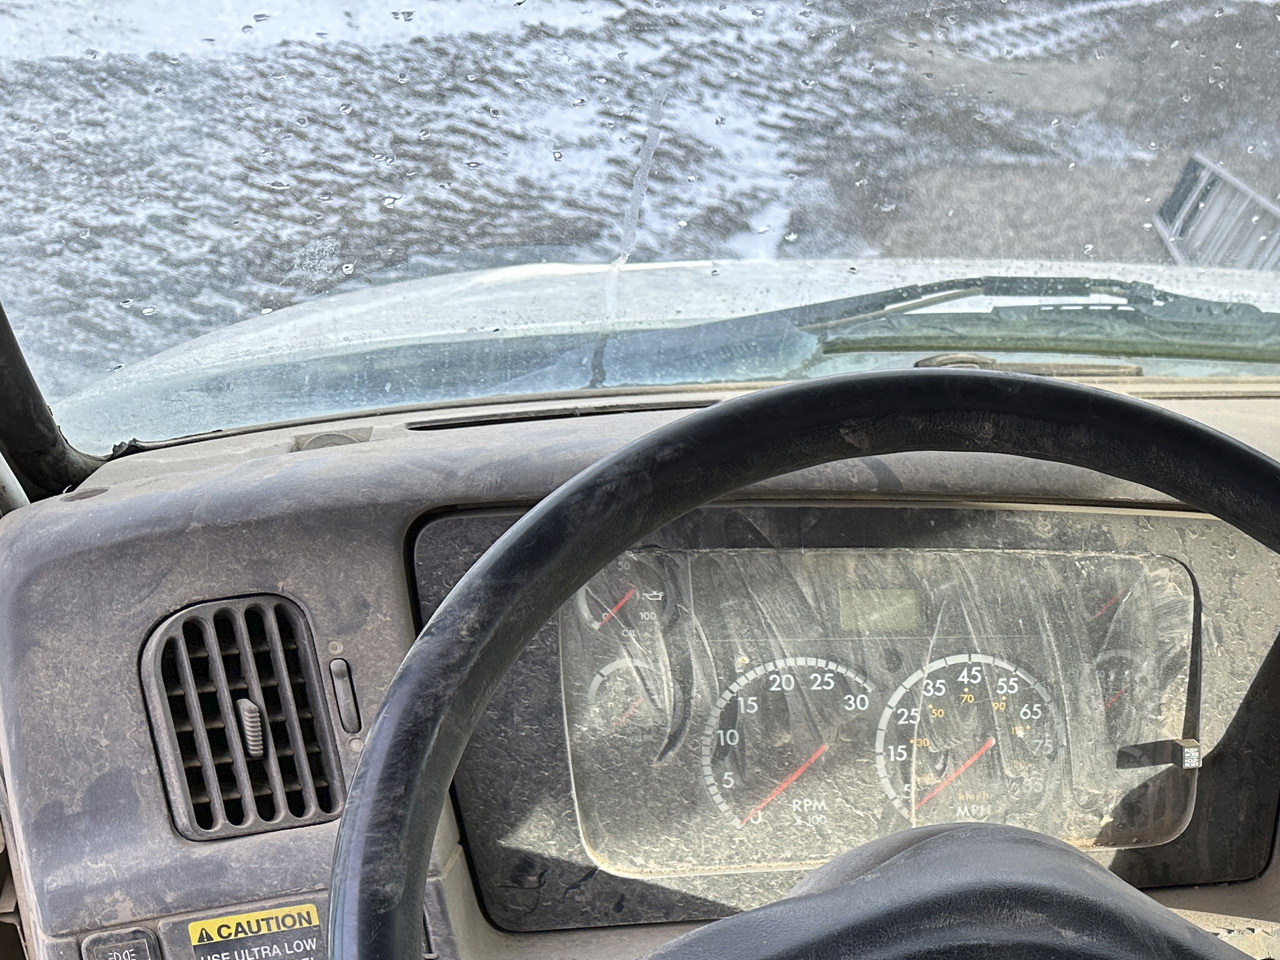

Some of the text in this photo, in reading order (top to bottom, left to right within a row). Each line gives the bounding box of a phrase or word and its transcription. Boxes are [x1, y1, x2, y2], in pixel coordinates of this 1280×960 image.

[640, 612, 657, 621] 100
[769, 674, 795, 692] 20
[810, 673, 835, 691] 25
[957, 666, 982, 684] 45
[922, 679, 946, 697] 35
[996, 677, 1019, 695] 55
[738, 696, 759, 714] 15
[844, 694, 869, 711] 30
[961, 694, 975, 704] 70
[993, 702, 1006, 711] 90
[897, 707, 921, 725] 25
[931, 708, 945, 718] 50
[1019, 703, 1042, 720] 65
[717, 729, 740, 746] 10
[916, 738, 930, 747] 30
[888, 745, 907, 762] 15
[1032, 739, 1054, 755] 75
[722, 772, 735, 788] 5
[792, 799, 827, 812] RPM
[956, 804, 991, 818] MPH
[808, 815, 828, 825] 100
[216, 910, 313, 941] CAUTION
[283, 937, 318, 956] LOW
